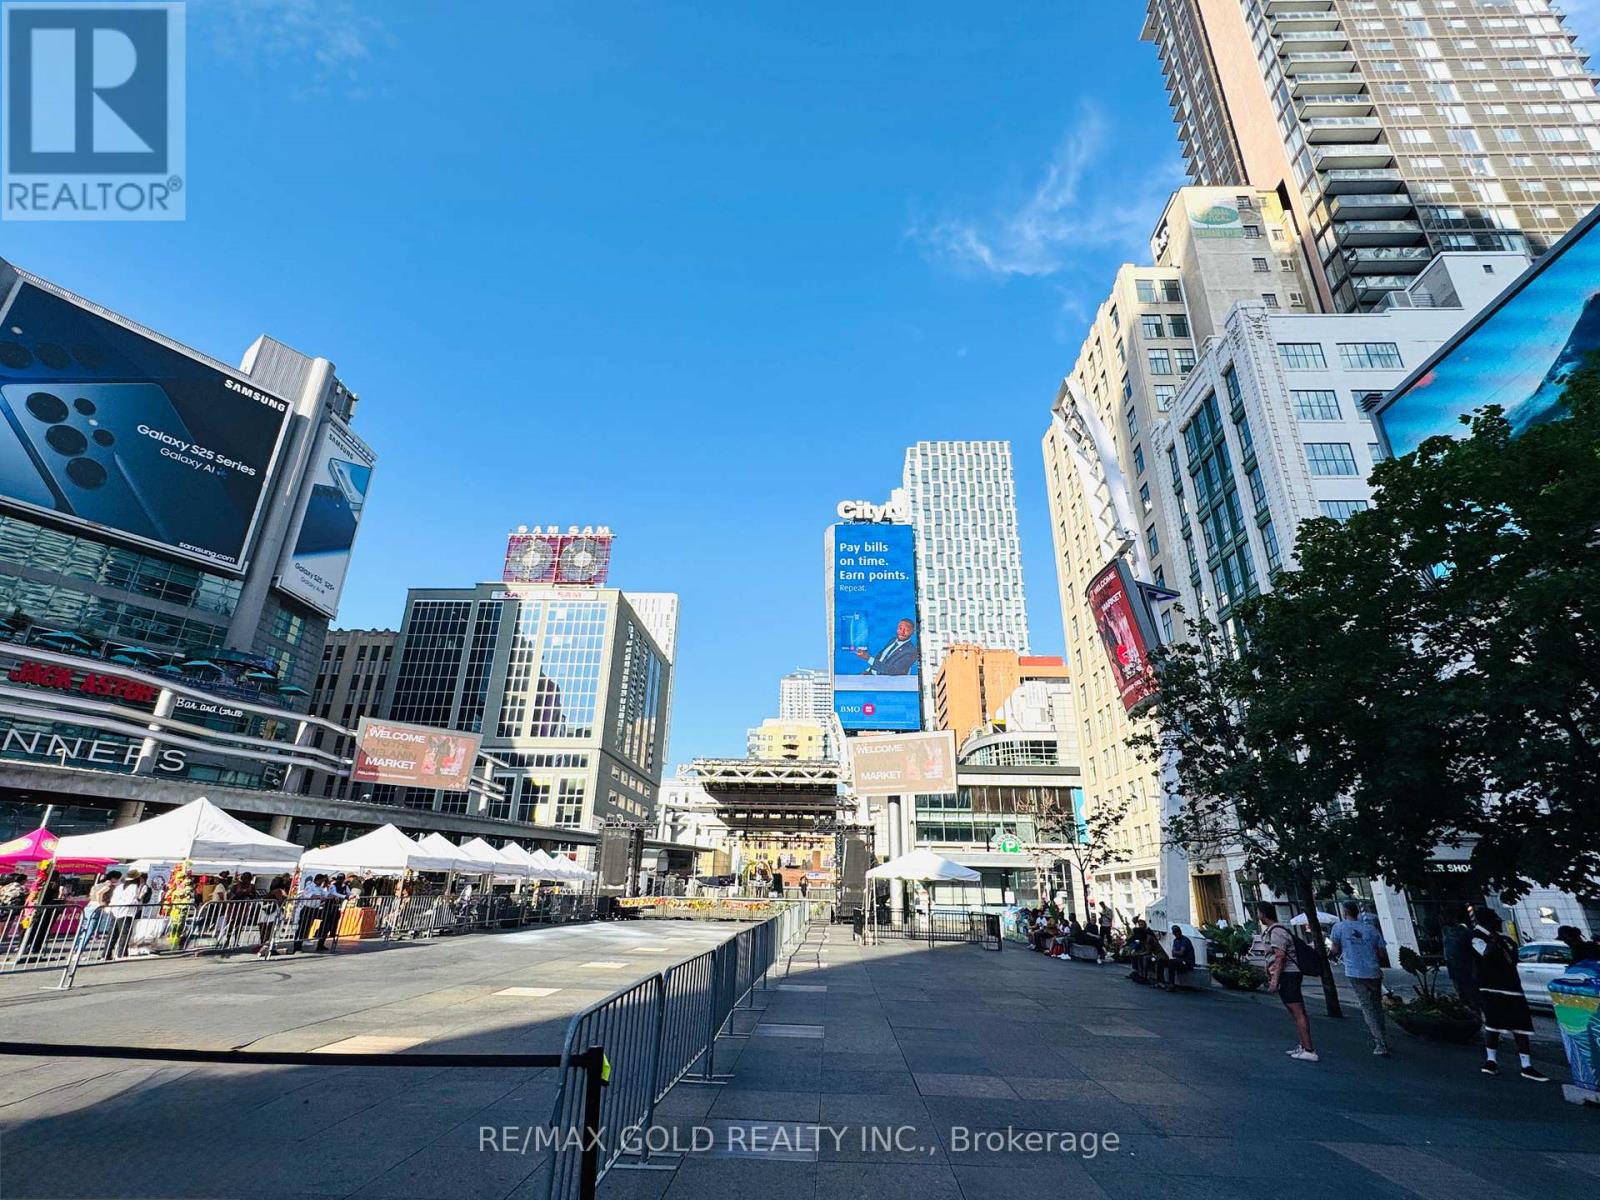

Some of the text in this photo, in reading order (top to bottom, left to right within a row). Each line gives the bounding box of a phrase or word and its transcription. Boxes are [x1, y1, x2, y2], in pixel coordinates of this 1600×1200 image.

[223, 378, 287, 413] SAMSUNG
[136, 424, 257, 477] Galaxy S25 Series
[159, 447, 216, 475] Galaxy AI
[517, 525, 611, 535] SAM SAM
[178, 541, 236, 563] samsung.com
[839, 541, 889, 555] Pay bills
[839, 555, 889, 566] on time.
[839, 569, 910, 582] Earn points.
[1094, 570, 1116, 595] WELCOME
[1101, 590, 1122, 612] MARKET
[8, 661, 74, 690] JACK
[840, 705, 861, 713] BMO
[369, 728, 426, 744] WELCOME
[856, 743, 904, 754] WELCOME
[364, 756, 417, 770] MARKET
[860, 770, 902, 780] MARKET
